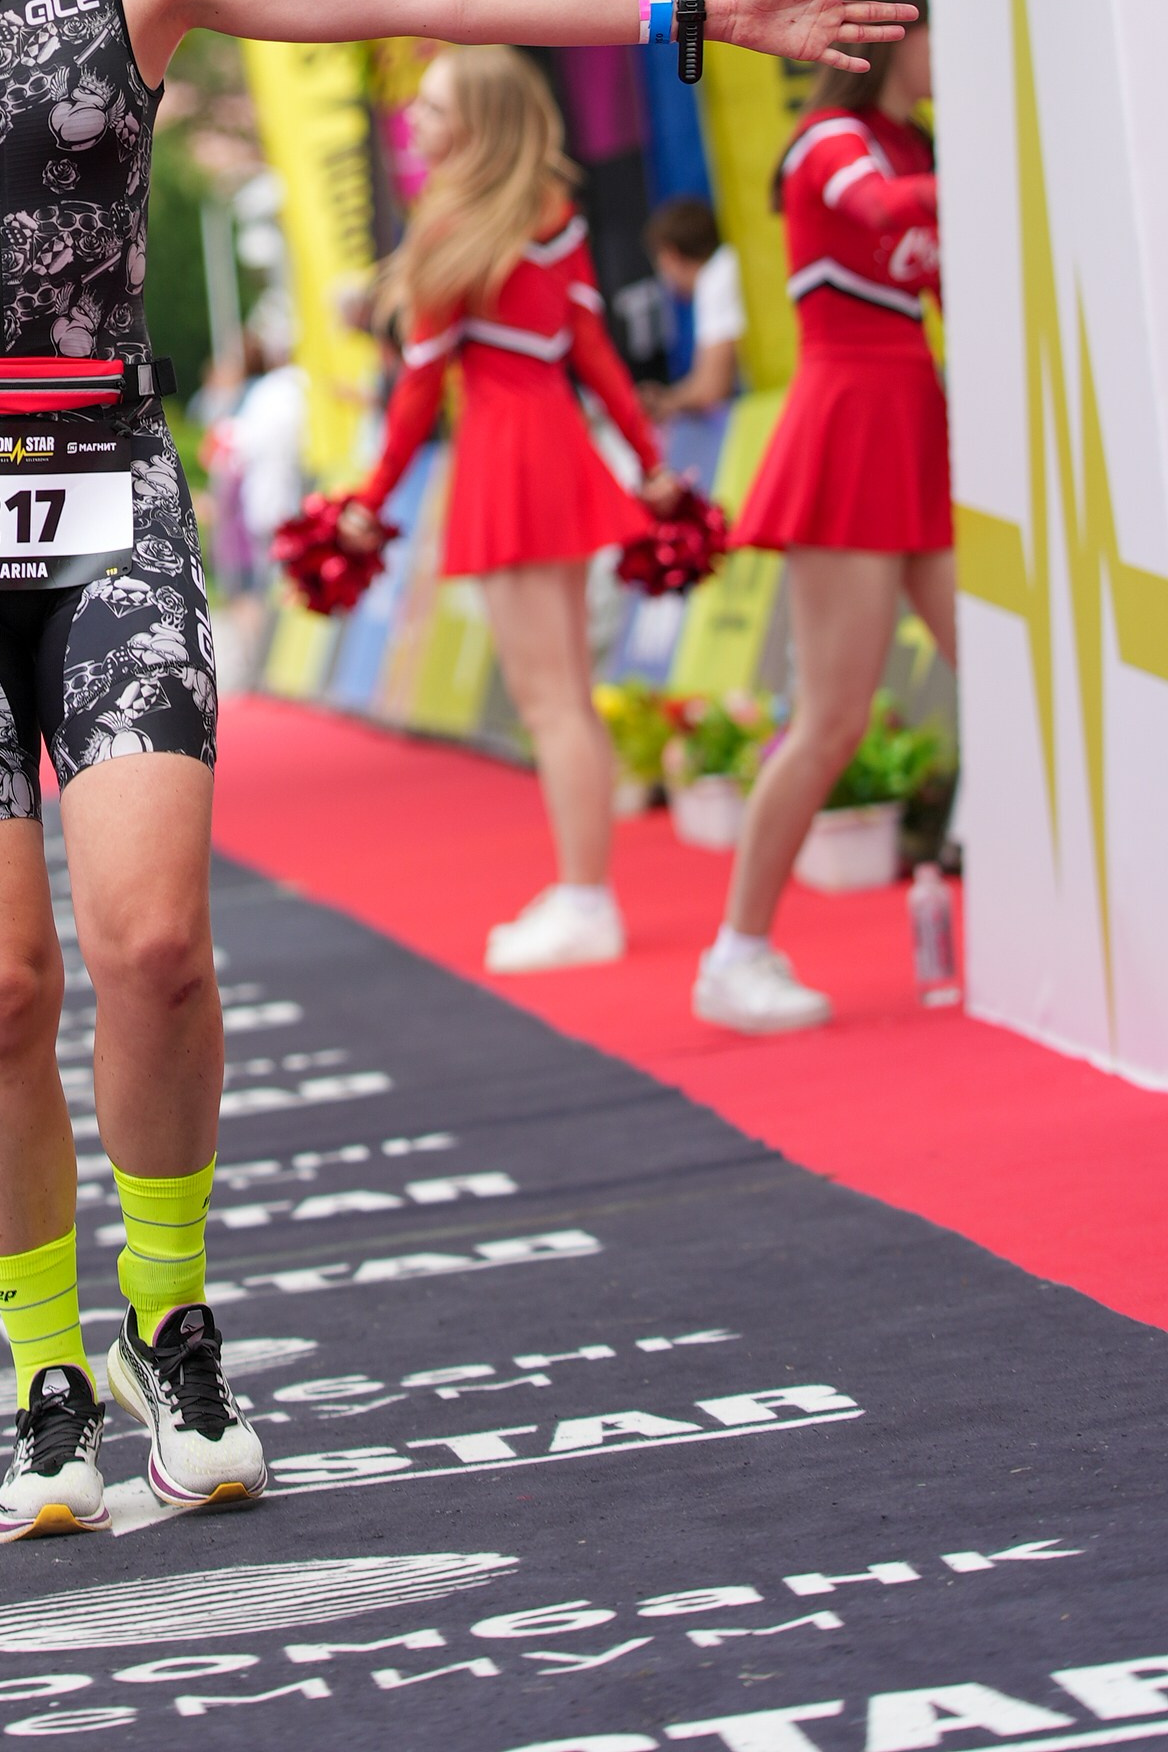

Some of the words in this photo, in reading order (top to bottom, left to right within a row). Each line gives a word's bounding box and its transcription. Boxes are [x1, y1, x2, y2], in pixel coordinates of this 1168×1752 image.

[25, 436, 55, 452] STAR
[79, 442, 117, 452] МАГНИТ
[269, 1384, 860, 1484] STAR
[492, 1656, 1168, 1752] TAR
